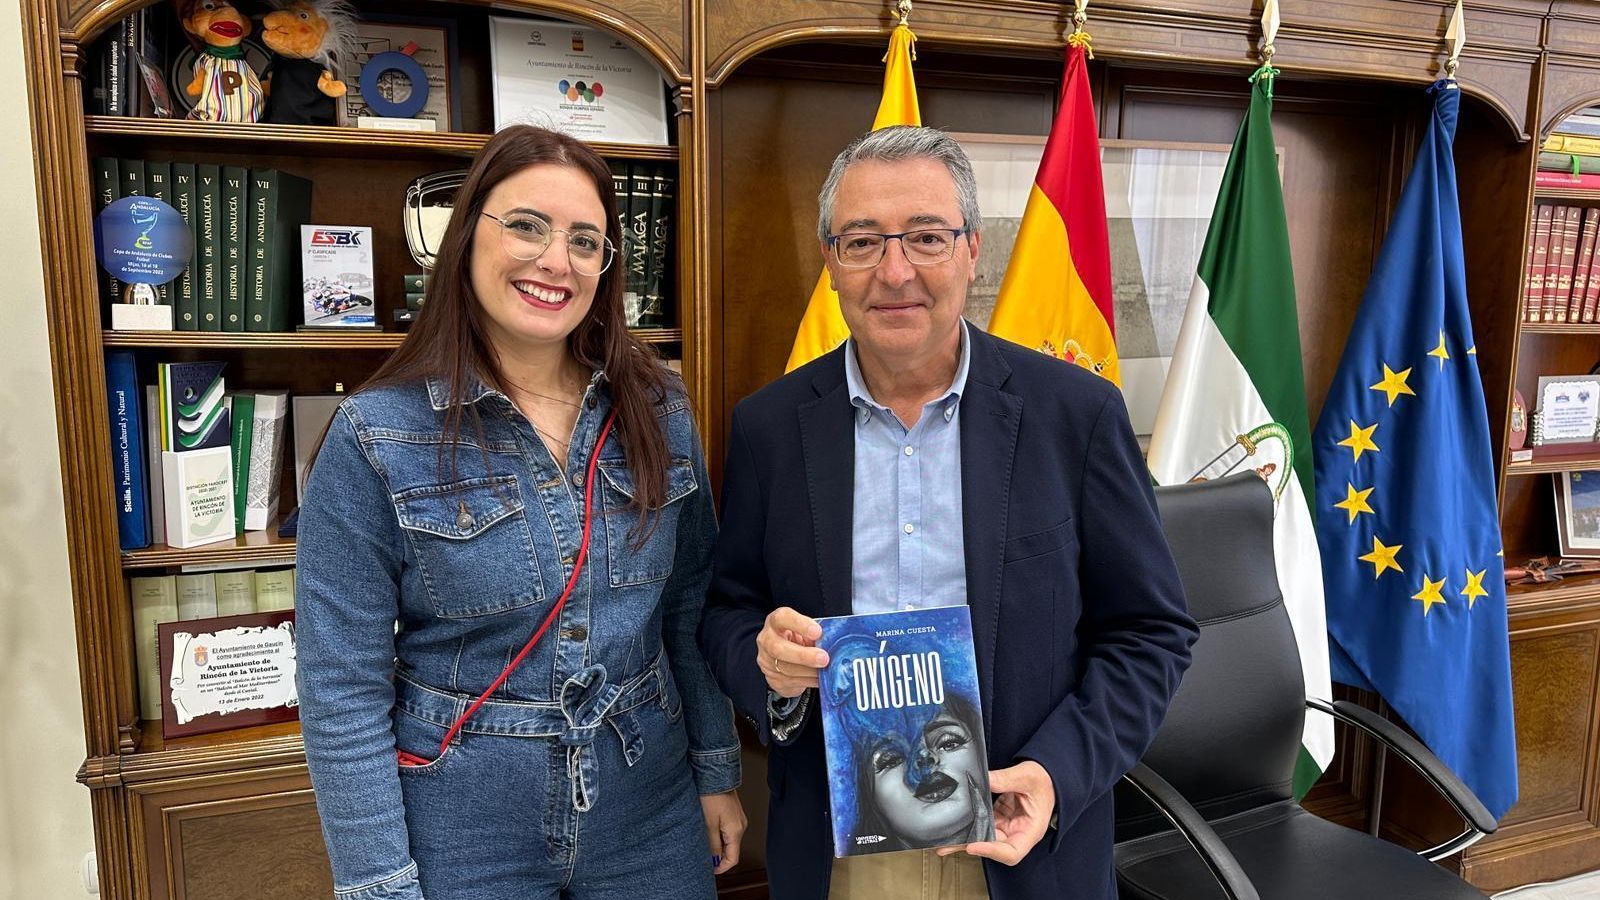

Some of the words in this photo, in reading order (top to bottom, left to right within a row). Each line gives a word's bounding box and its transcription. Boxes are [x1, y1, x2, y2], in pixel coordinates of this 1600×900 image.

[527, 60, 566, 68] Ayuntamiento
[574, 62, 594, 70] Rincón
[608, 64, 632, 72] Victoria
[222, 71, 242, 95] P
[130, 172, 136, 180] II
[154, 174, 162, 182] III
[178, 176, 188, 184] IV
[204, 178, 211, 186] V
[228, 180, 239, 188] VI
[256, 180, 270, 188] VII
[637, 182, 648, 190] III
[203, 194, 212, 241] ANDALUCÍA
[228, 196, 238, 242] ANDALUCÍA
[256, 197, 266, 242] ANDALUCÍA
[205, 246, 212, 256] DE
[230, 247, 238, 258] DE
[256, 248, 264, 258] DE
[205, 264, 213, 299] HISTORIA
[230, 264, 238, 300] HISTORIA
[256, 265, 264, 300] HISTORIA
[116, 390, 126, 416] Natural
[118, 422, 128, 450] Cultural
[122, 450, 130, 486] Patrimonio
[124, 488, 132, 512] Sicilia.
[190, 495, 226, 505] AYUNTAMIENTO
[200, 502, 218, 510] RINCÓN
[201, 508, 223, 516] VICTORIA
[907, 626, 936, 634] CUESTA
[219, 645, 255, 653] Ayuntamiento
[233, 649, 274, 659] agradecimiento
[207, 660, 260, 671] Ayuntamiento
[200, 671, 227, 680] Rincón
[249, 665, 278, 673] Victoria
[852, 640, 944, 712] OXÍGENO
